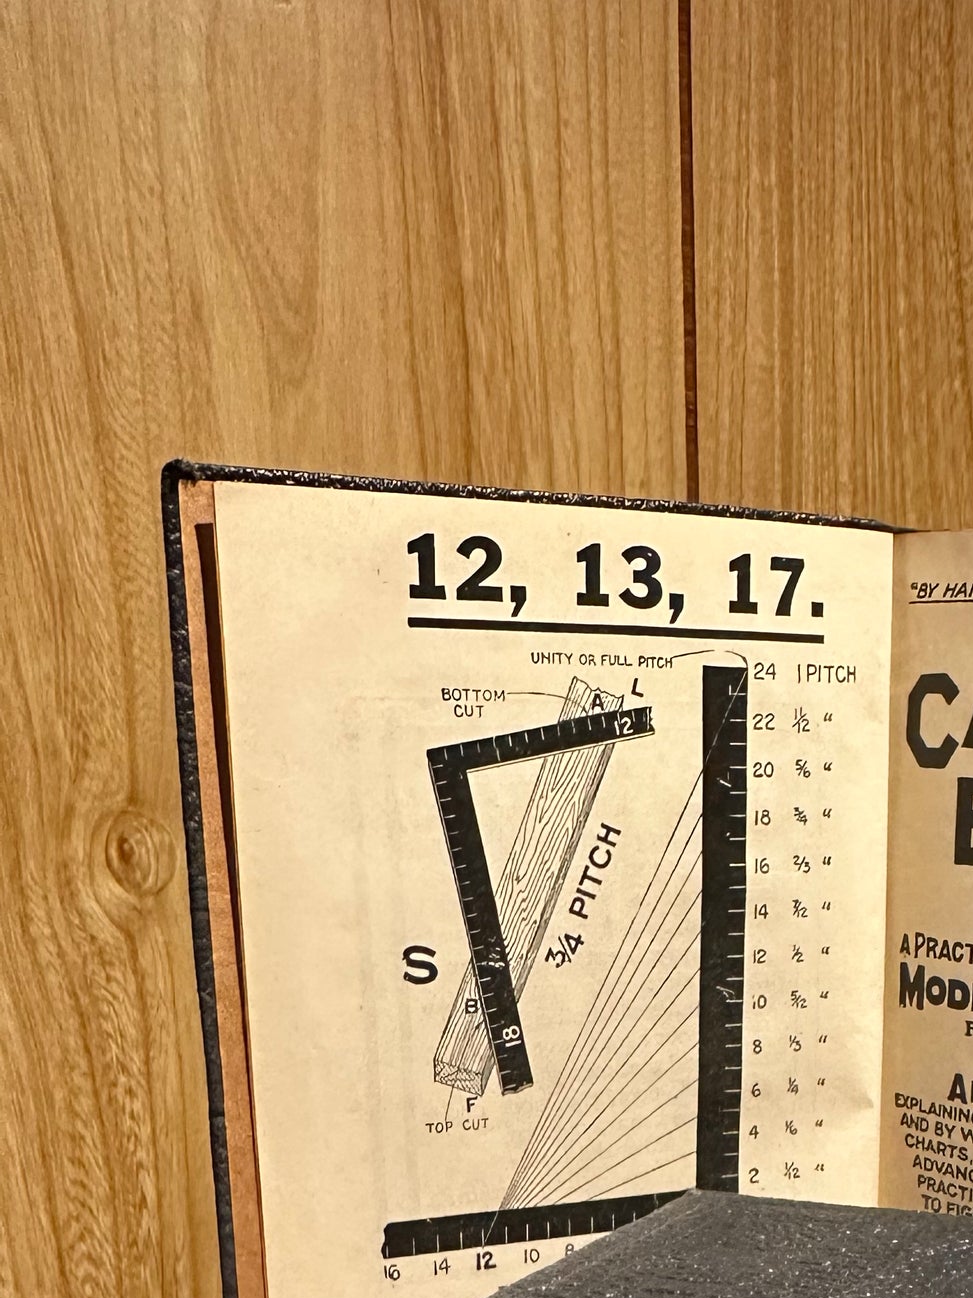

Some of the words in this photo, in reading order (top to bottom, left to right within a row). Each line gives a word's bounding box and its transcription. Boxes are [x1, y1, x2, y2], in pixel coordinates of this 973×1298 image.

[407, 533, 527, 617] 12,
[576, 543, 684, 624] 13,
[728, 553, 824, 617] 17.
[530, 651, 574, 667] UNITY
[579, 652, 597, 667] OR
[601, 654, 634, 668] FULL
[638, 655, 674, 669] PITCH
[753, 662, 777, 681] 24
[806, 664, 857, 684] PITCH
[441, 687, 506, 703] BOTTOM
[631, 677, 644, 698] L
[591, 693, 605, 711] A
[453, 704, 484, 719] CUT
[614, 716, 634, 736] 12
[752, 713, 776, 731] 22
[752, 762, 775, 778] 20
[754, 809, 772, 826] 18
[754, 858, 770, 874] 16
[544, 931, 585, 969] 3/4
[568, 821, 622, 920] PITCH
[754, 903, 769, 919] 14
[899, 933, 911, 957] A
[402, 945, 439, 985] S
[753, 948, 767, 964] 12
[752, 994, 768, 1010] 10
[502, 1025, 523, 1048] 18
[752, 1039, 763, 1054] 8
[751, 1083, 762, 1098] 6
[466, 1096, 479, 1113] F
[425, 1120, 453, 1134] TOP
[462, 1117, 490, 1132] CUT
[748, 1125, 760, 1140] 4
[900, 1112, 929, 1133] AND
[934, 1121, 957, 1139] BY
[904, 1133, 973, 1166] CHARTS,
[748, 1168, 760, 1184] 2
[921, 1194, 942, 1213] TO
[383, 1264, 401, 1281] 16
[433, 1257, 451, 1275] 14
[476, 1251, 497, 1271] 12
[523, 1248, 540, 1264] 10
